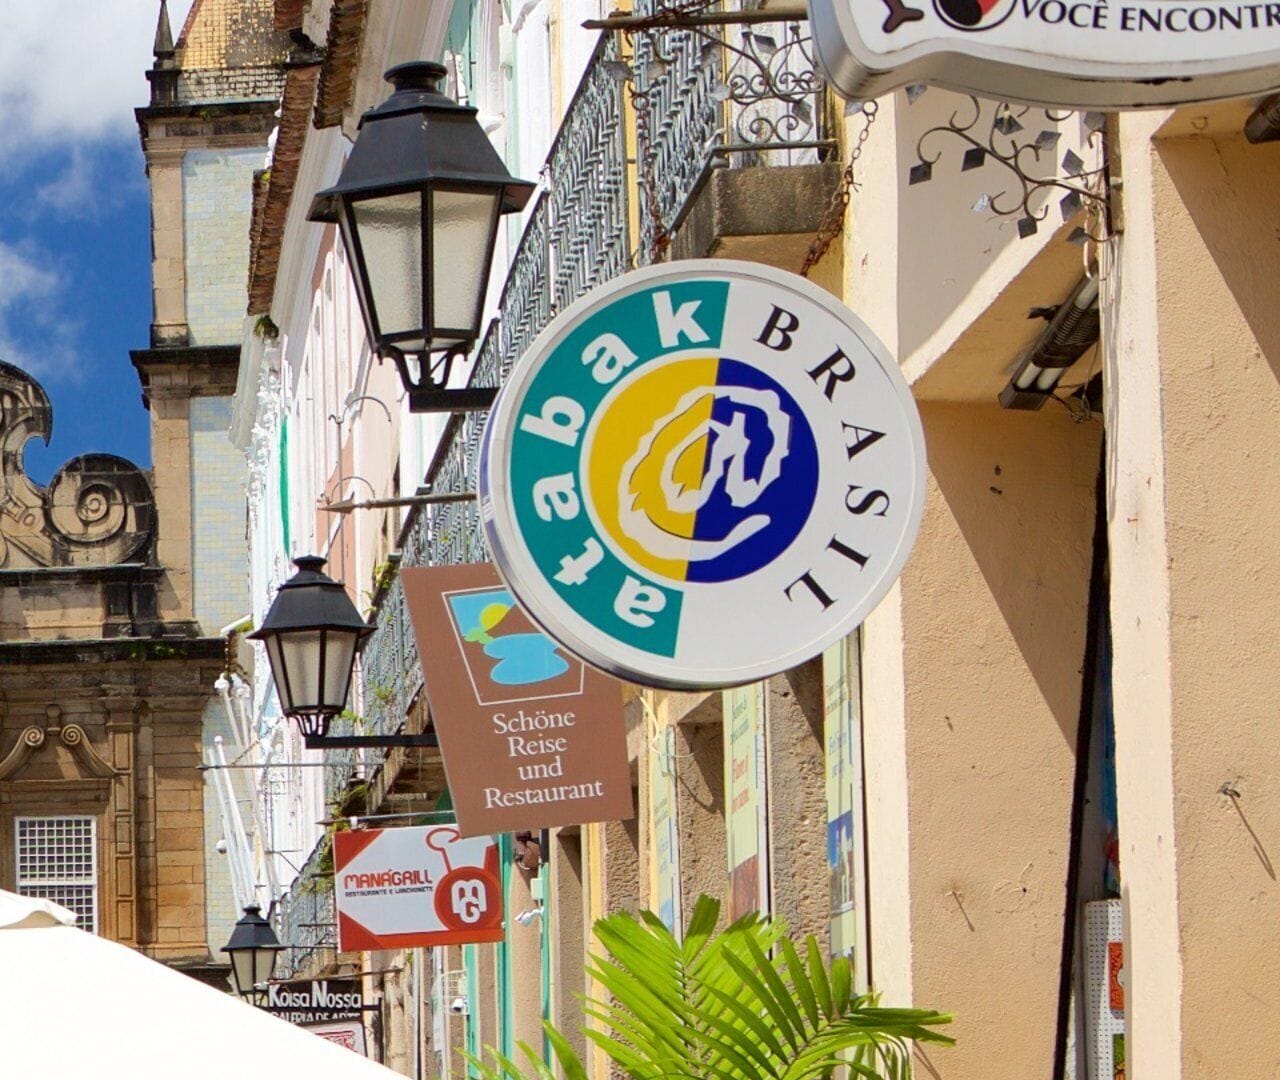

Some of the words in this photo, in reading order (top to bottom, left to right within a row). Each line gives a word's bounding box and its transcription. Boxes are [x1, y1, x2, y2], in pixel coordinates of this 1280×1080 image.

[1020, 0, 1108, 30] VOCÊ
[1120, 2, 1280, 32] ENCONTR
[520, 291, 710, 630] atabak
[753, 304, 891, 615] BRASIL
[492, 710, 576, 734] Schöne
[506, 733, 568, 758] Reise
[518, 755, 564, 781] und
[483, 780, 605, 809] Restaurant
[312, 981, 362, 1009] Nossa
